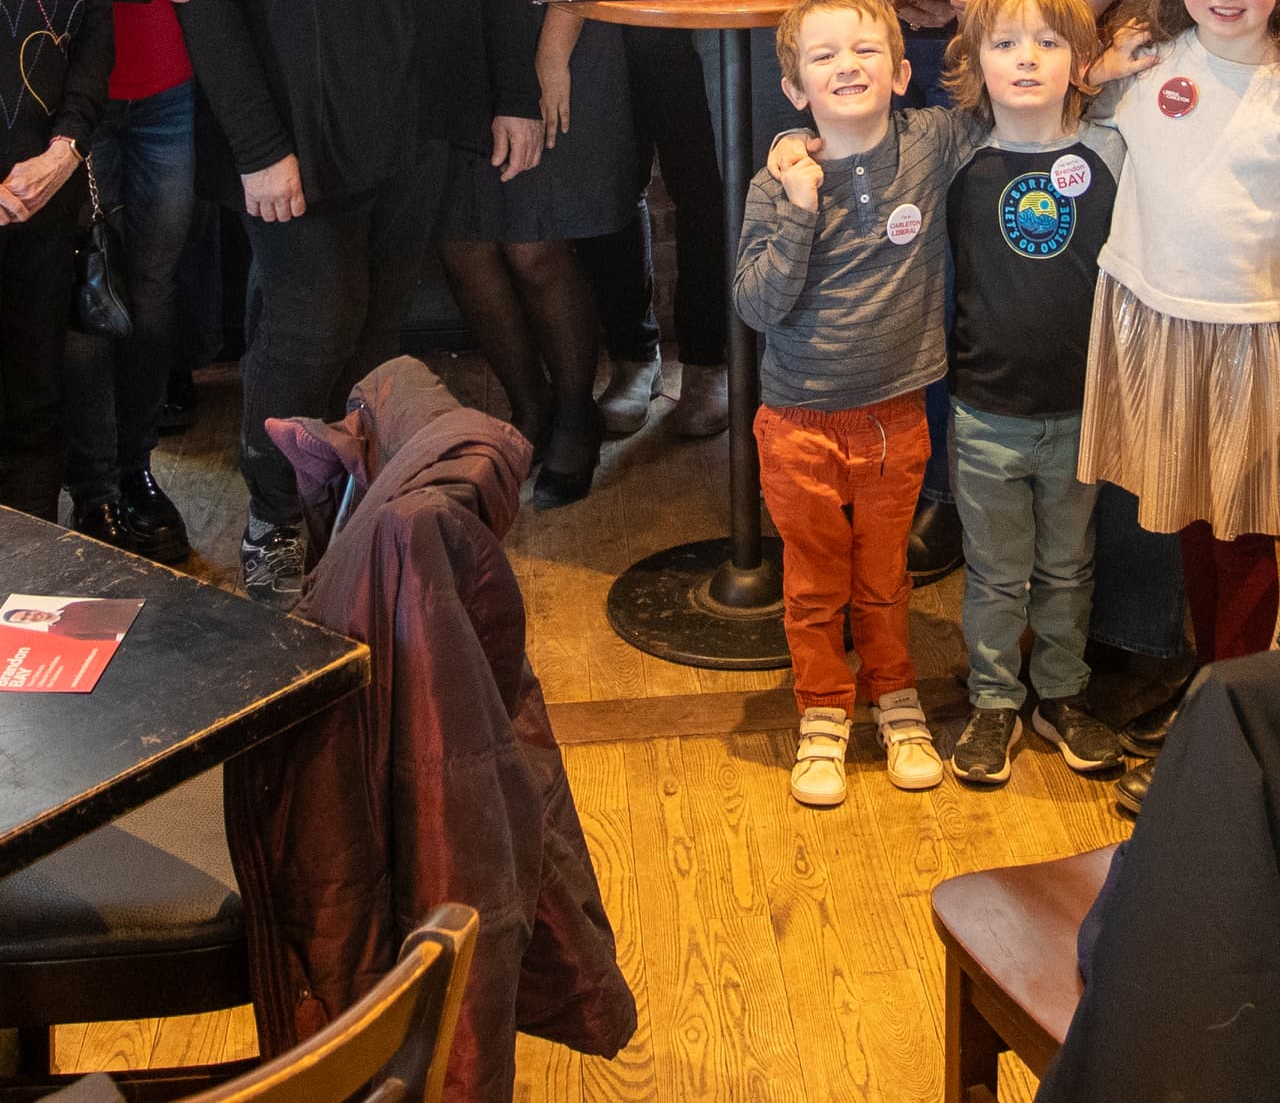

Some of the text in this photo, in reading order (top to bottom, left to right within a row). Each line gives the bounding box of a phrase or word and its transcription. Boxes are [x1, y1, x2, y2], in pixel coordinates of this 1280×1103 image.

[1055, 164, 1085, 177] Brandon
[1057, 171, 1086, 189] BAY
[1004, 206, 1070, 253] LET'S GO OUTSIDE
[8, 667, 33, 688] BAY
